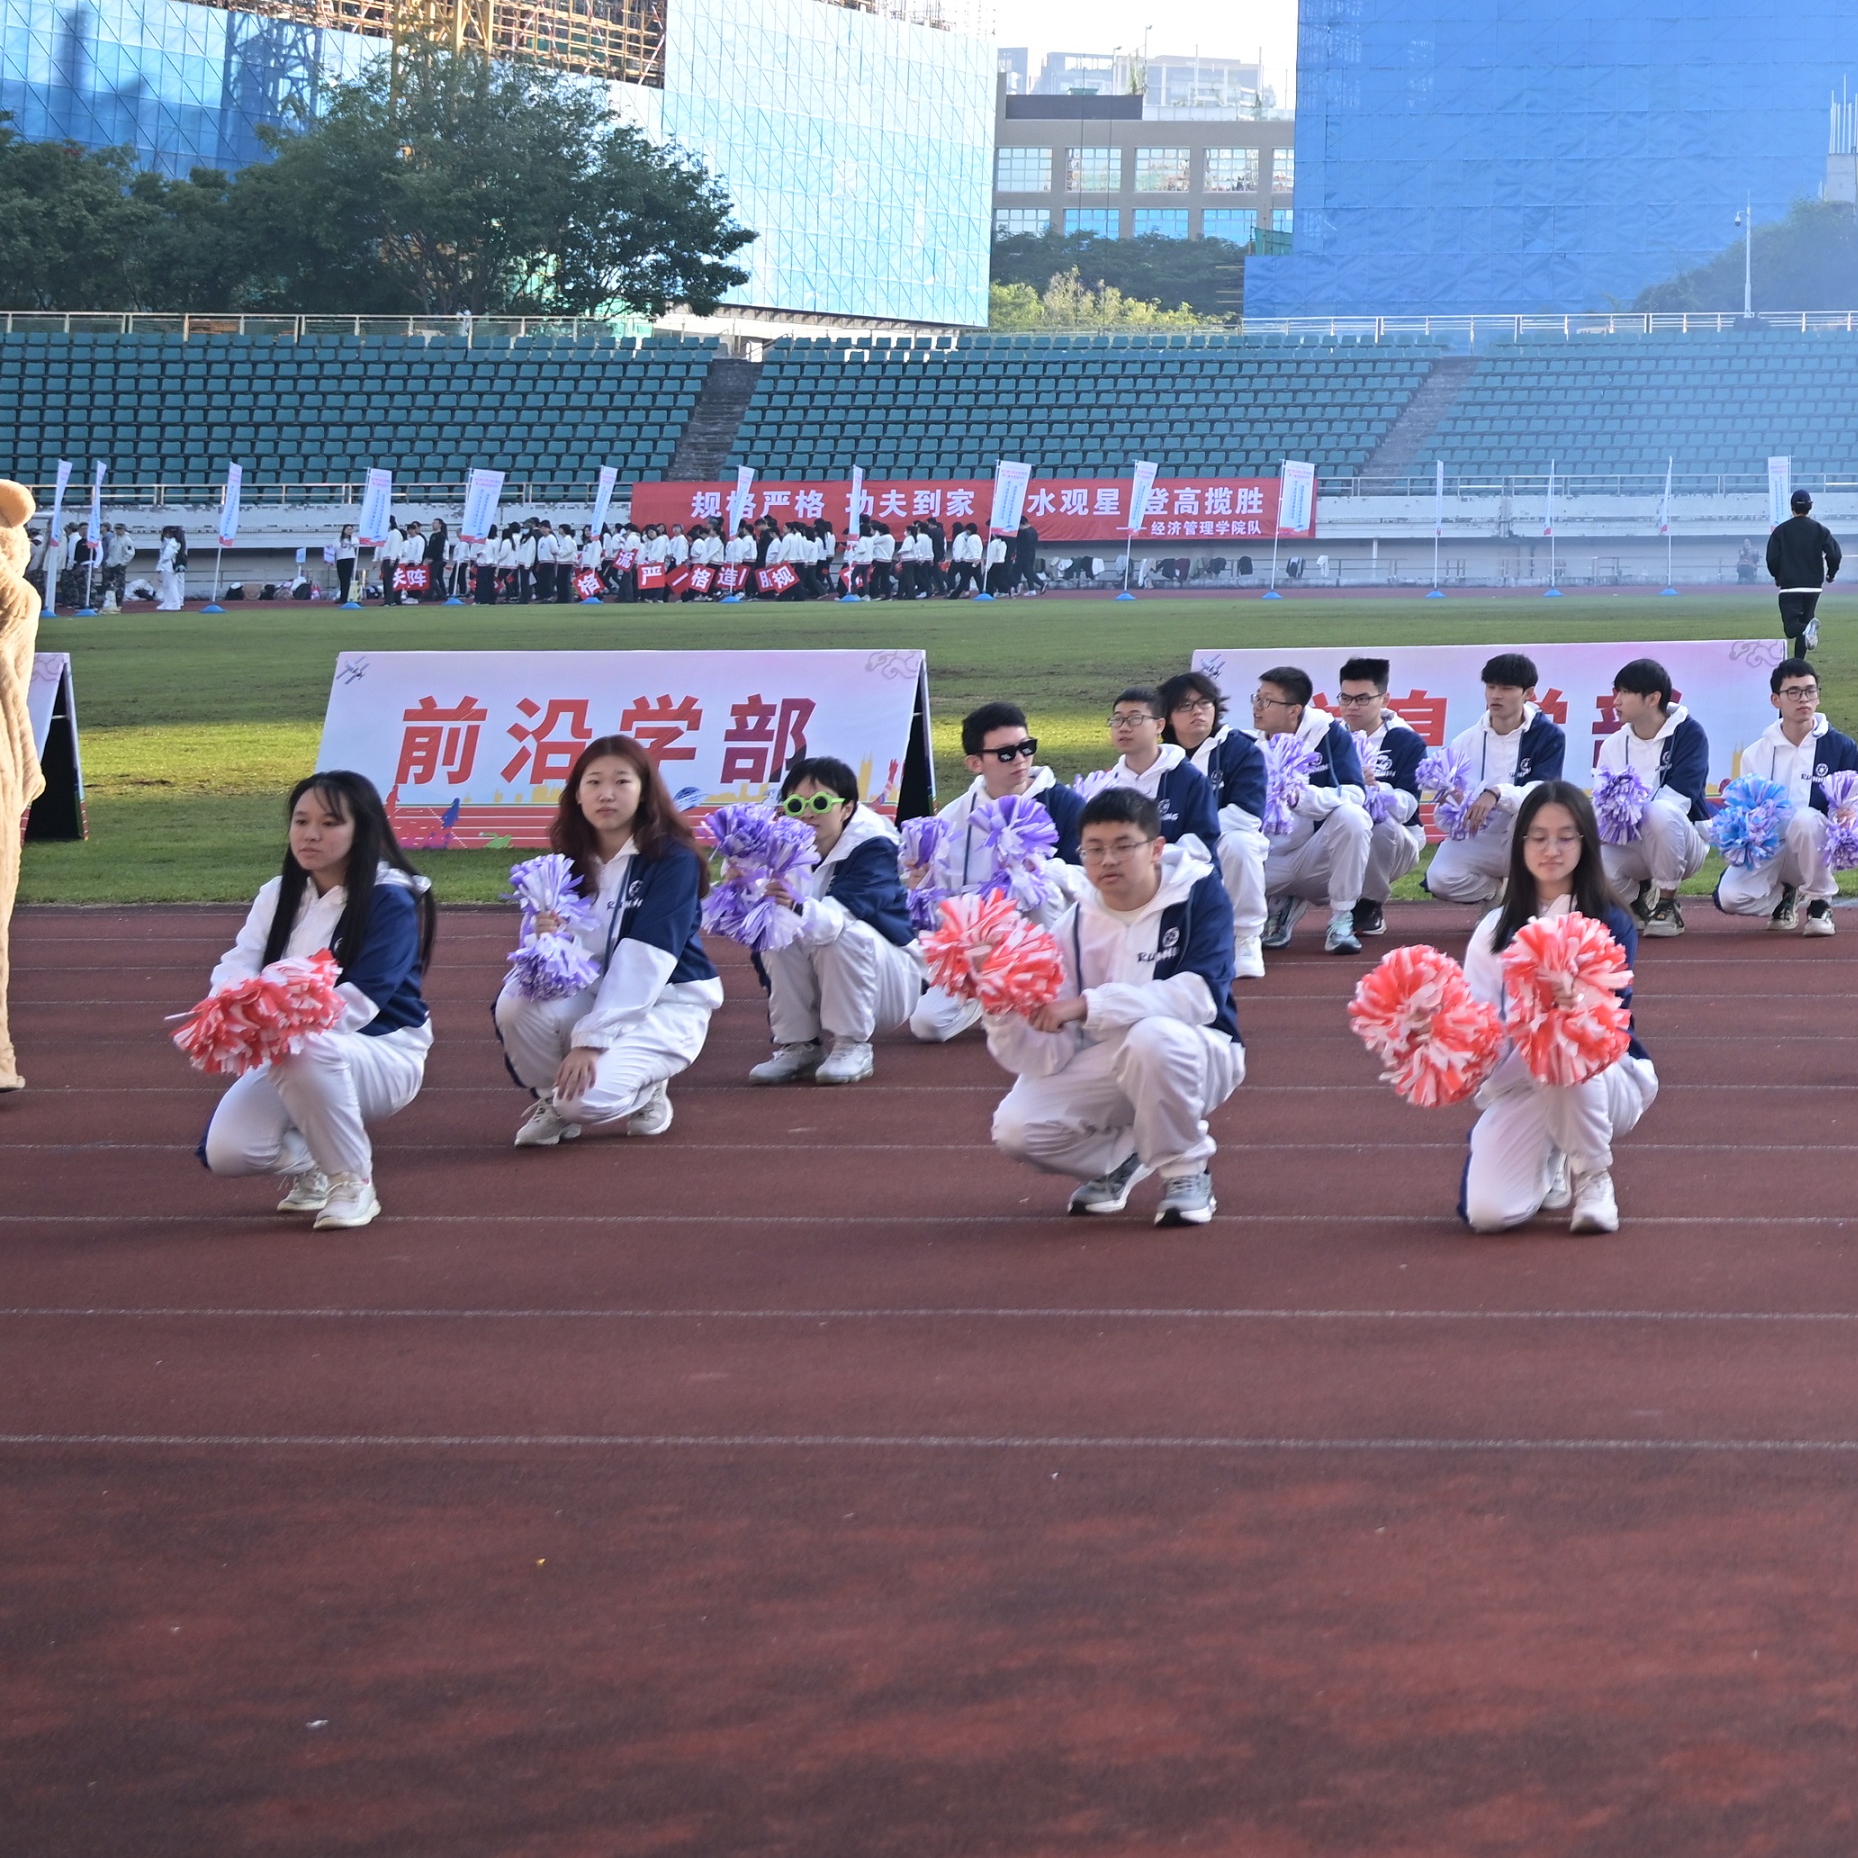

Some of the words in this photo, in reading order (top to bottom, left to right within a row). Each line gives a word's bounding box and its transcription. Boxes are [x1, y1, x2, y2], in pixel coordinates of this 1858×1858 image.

[691, 490, 825, 519] 规格严格
[845, 488, 975, 517] 功夫到家
[1028, 487, 1120, 516] 水观星
[1143, 487, 1264, 515] 登高揽胜
[617, 551, 634, 568] 流
[641, 566, 662, 585] 严
[691, 568, 711, 589] 格
[772, 566, 795, 588] 规
[395, 693, 817, 785] 前沿学部
